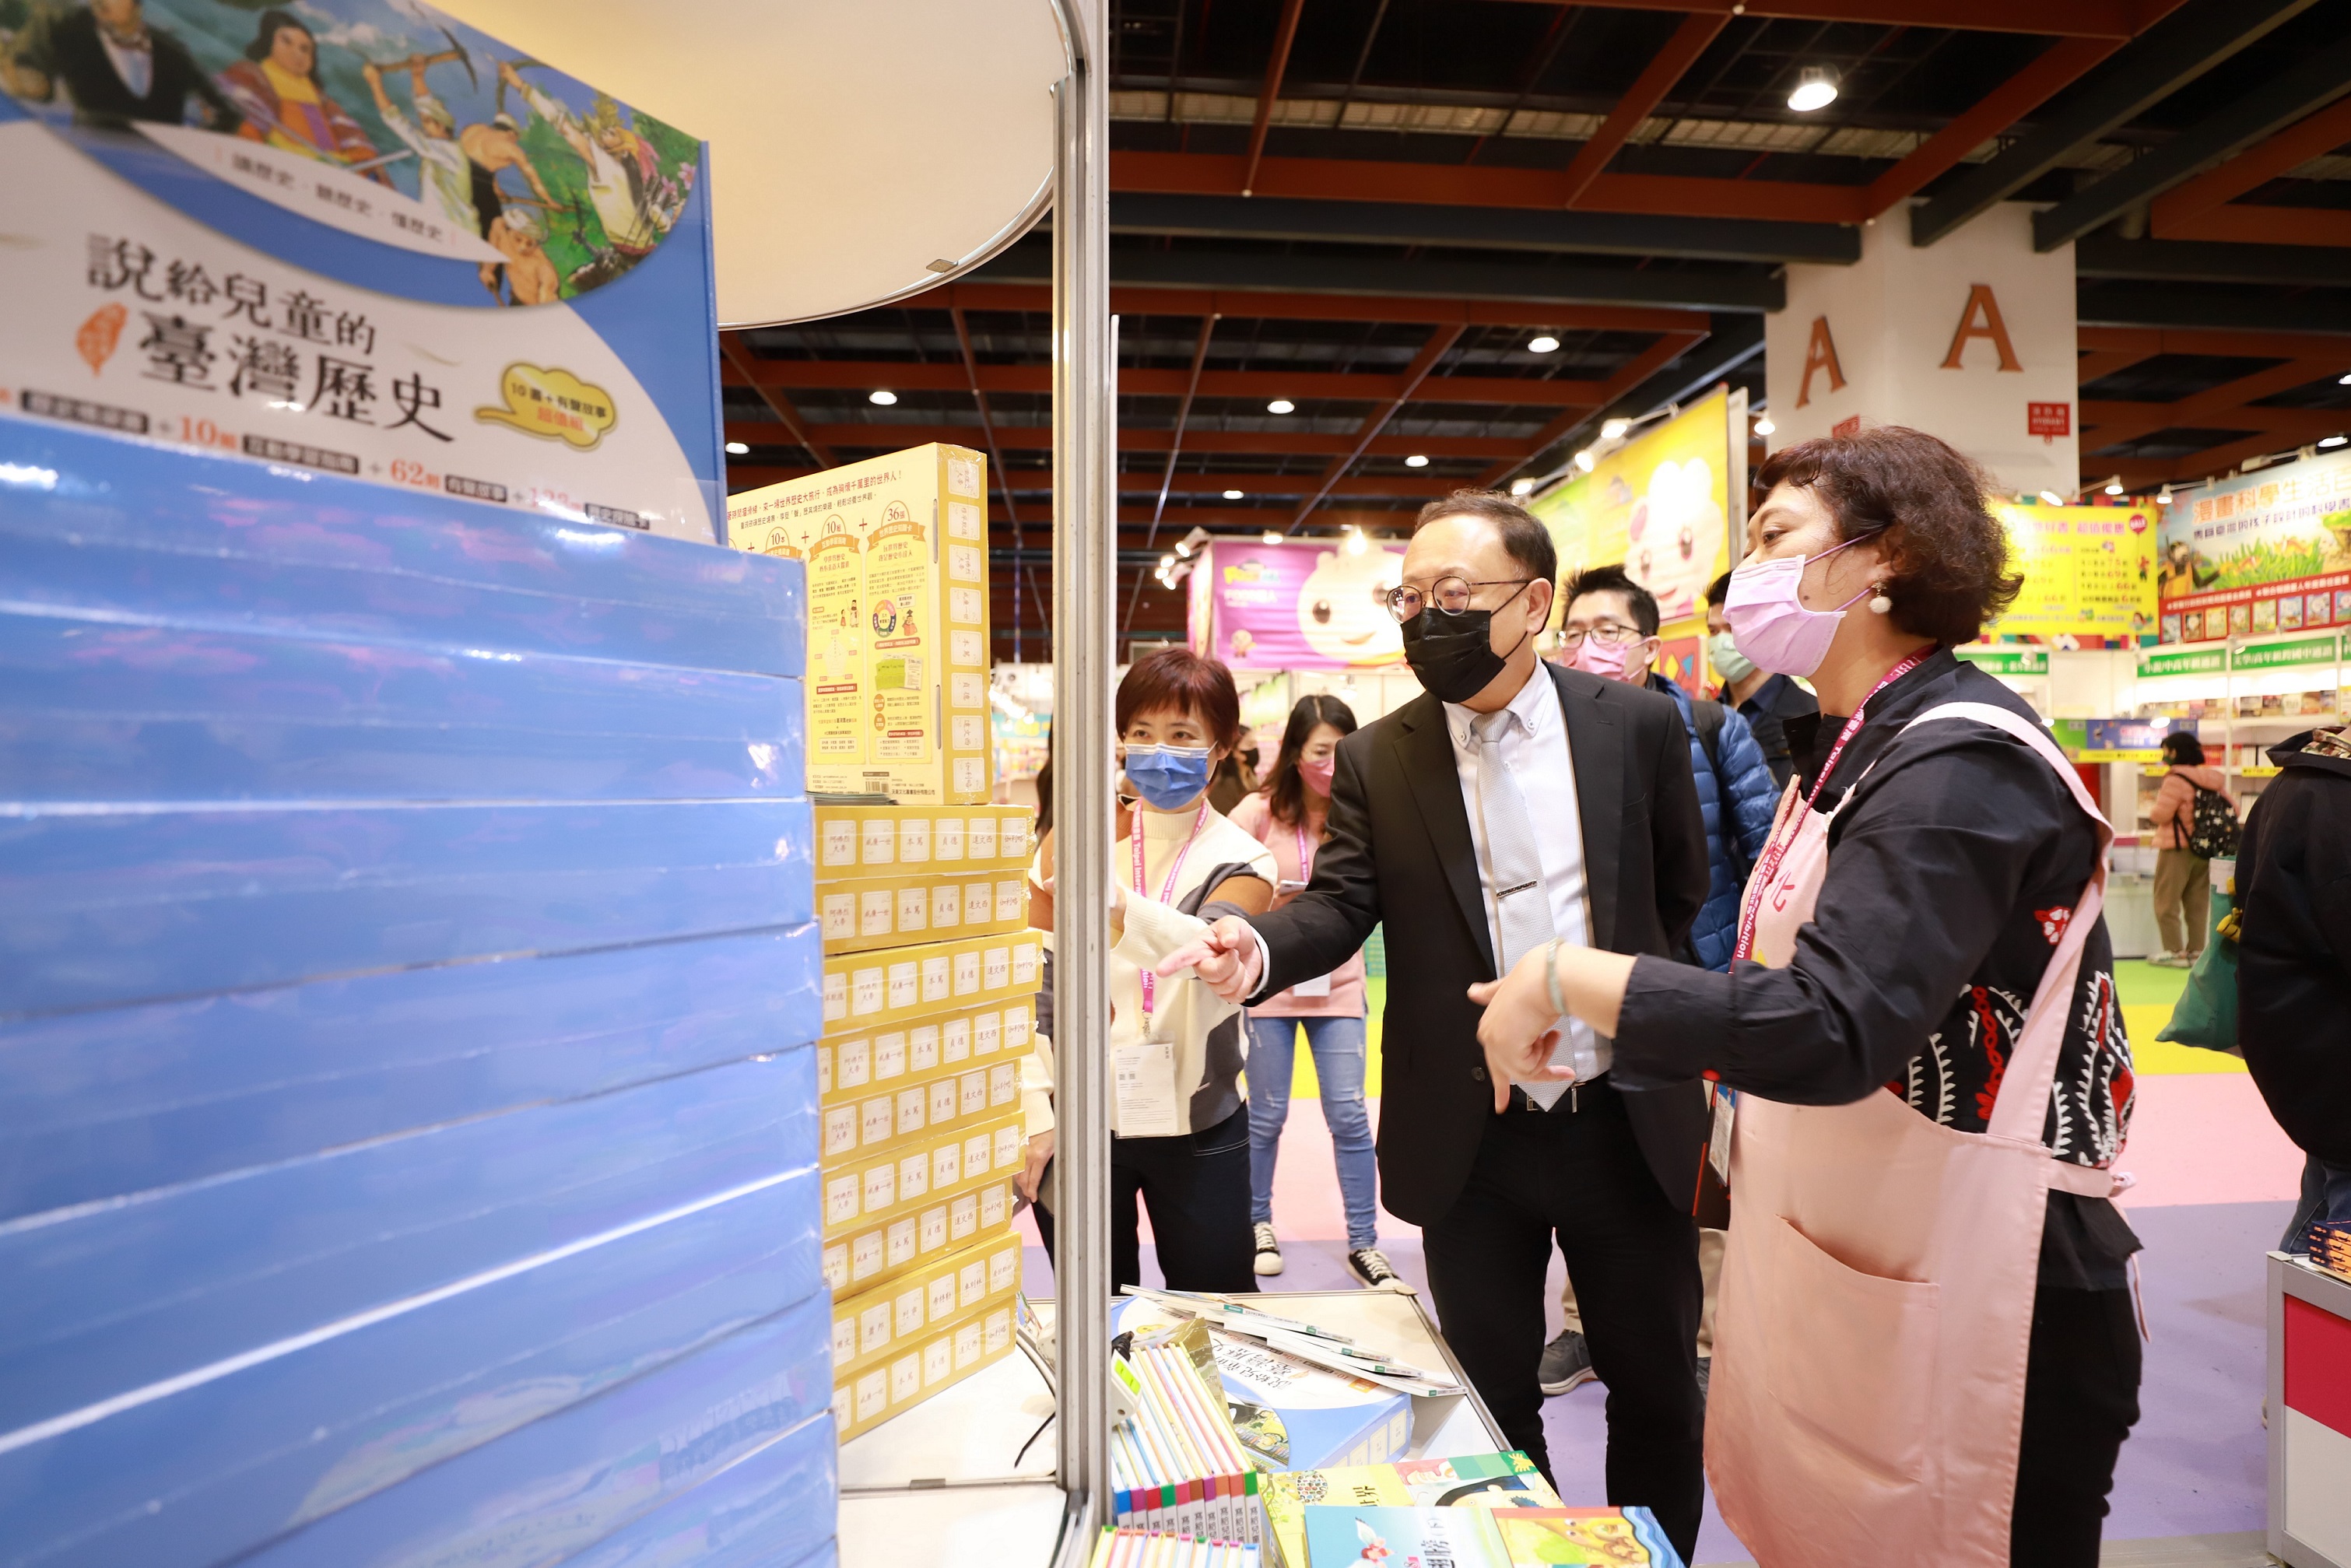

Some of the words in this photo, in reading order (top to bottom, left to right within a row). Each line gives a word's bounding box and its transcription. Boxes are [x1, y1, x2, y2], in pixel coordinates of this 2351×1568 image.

[86, 233, 376, 355] 說給兒童的
[1939, 283, 2024, 372] A
[1795, 315, 1847, 409] A
[139, 311, 455, 444] 臺灣歷史
[942, 836, 958, 845] 貞德
[972, 835, 992, 844] 達文西
[833, 844, 846, 853] 大帝
[1133, 842, 1142, 867] Taipei
[939, 903, 953, 913] 貞德
[968, 900, 988, 910] 達文西
[833, 918, 846, 927] 大帝
[960, 970, 974, 980] 貞德
[988, 966, 1005, 975] 達文西
[861, 992, 873, 1001] 大帝
[978, 1030, 997, 1040] 達文西
[949, 1037, 964, 1048] 貞德
[847, 1065, 859, 1074] 大帝
[964, 1089, 983, 1100] 達文西
[936, 1097, 951, 1108] 貞德
[835, 1131, 847, 1140] 大帝
[968, 1152, 987, 1163] 達文西
[939, 1162, 954, 1173] 貞德
[837, 1201, 849, 1211] 大帝
[955, 1214, 973, 1226] 達文西
[927, 1226, 942, 1237] 貞德
[826, 1272, 839, 1280] 大帝
